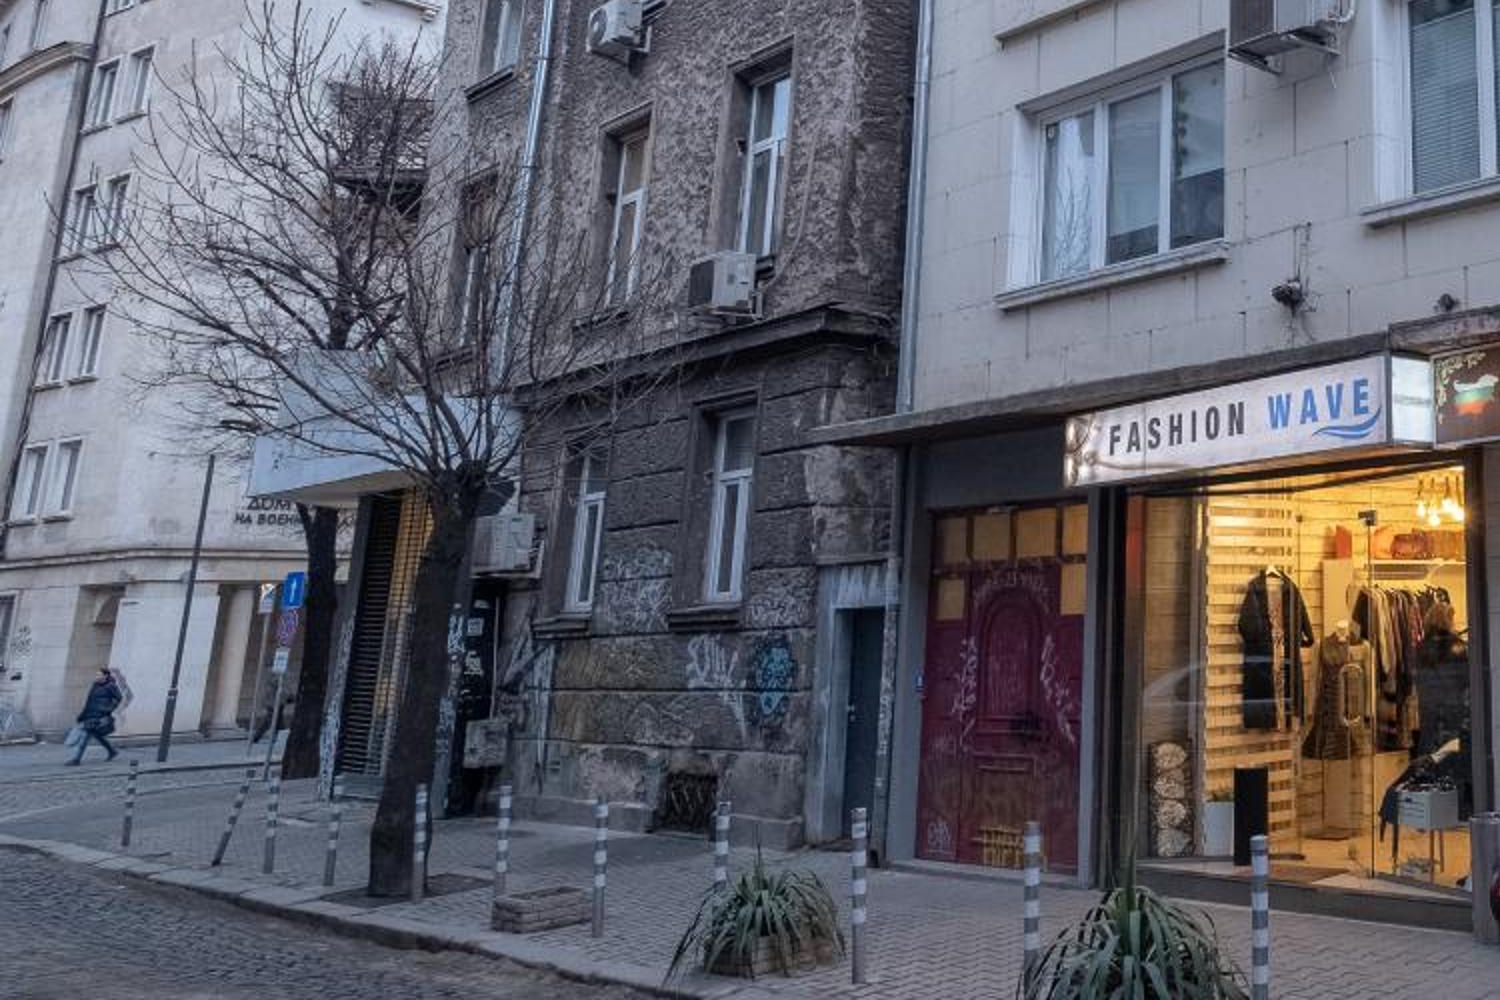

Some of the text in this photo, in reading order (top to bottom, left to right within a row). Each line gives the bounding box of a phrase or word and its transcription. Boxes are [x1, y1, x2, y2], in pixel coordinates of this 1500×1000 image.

[1108, 378, 1369, 457] FASHION WAVE
[246, 494, 291, 511] ДОМ
[234, 512, 252, 525] НА
